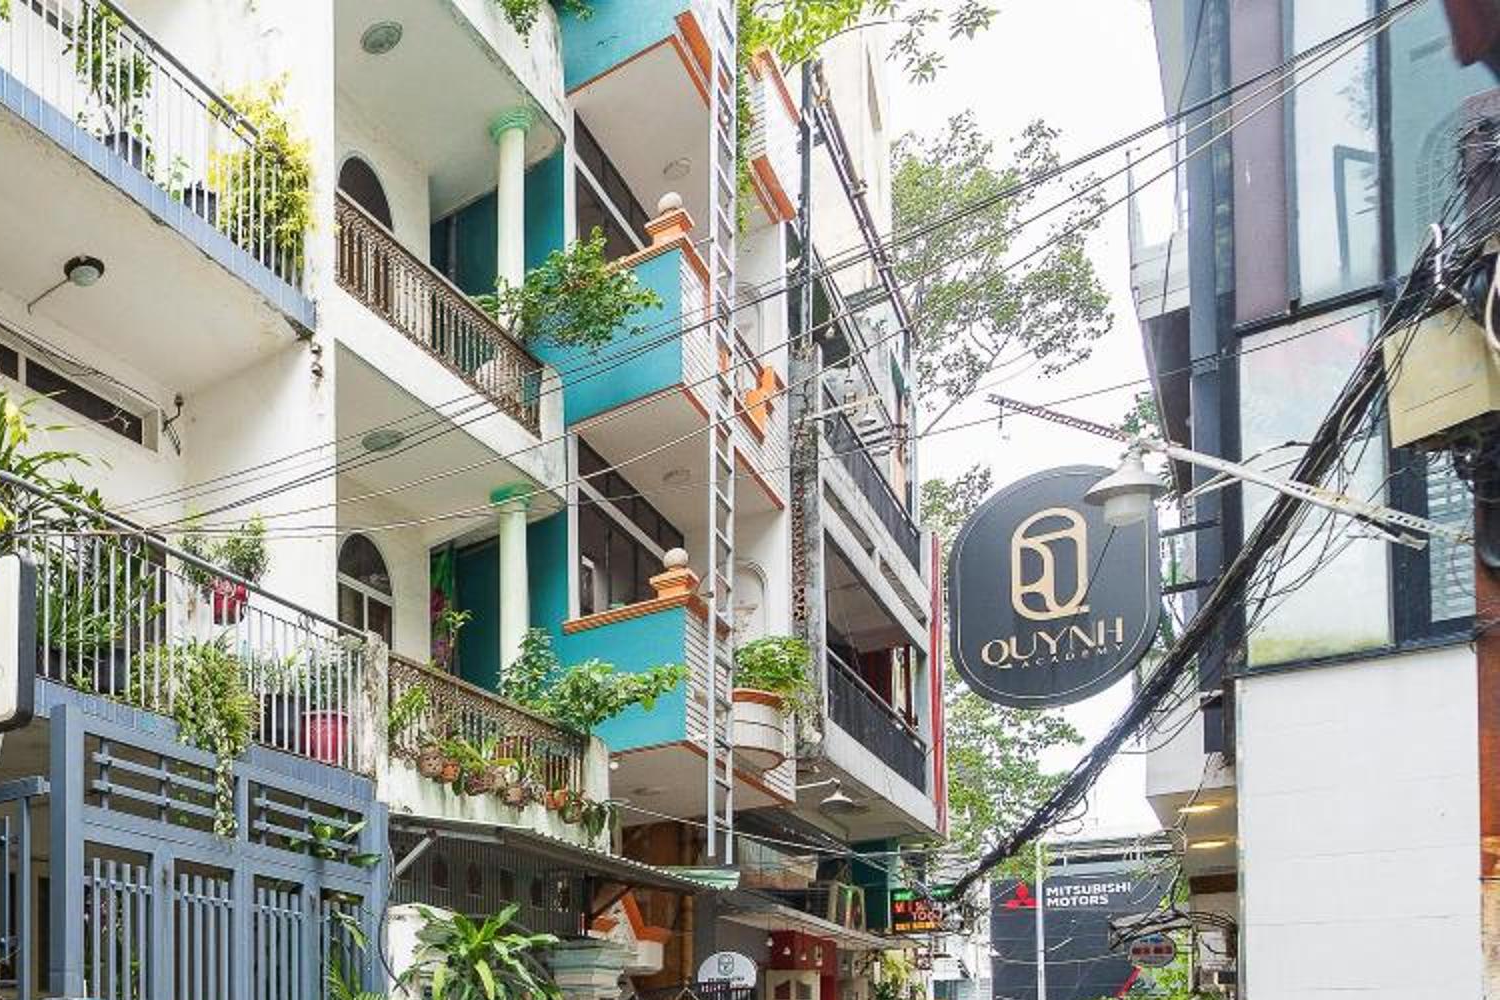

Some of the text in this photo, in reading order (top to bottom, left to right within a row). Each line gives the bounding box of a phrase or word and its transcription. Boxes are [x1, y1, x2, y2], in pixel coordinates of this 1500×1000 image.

[981, 617, 1124, 669] QUYNH
[1045, 881, 1131, 897] MITSUBISHI
[1046, 894, 1109, 907] MOTORS
